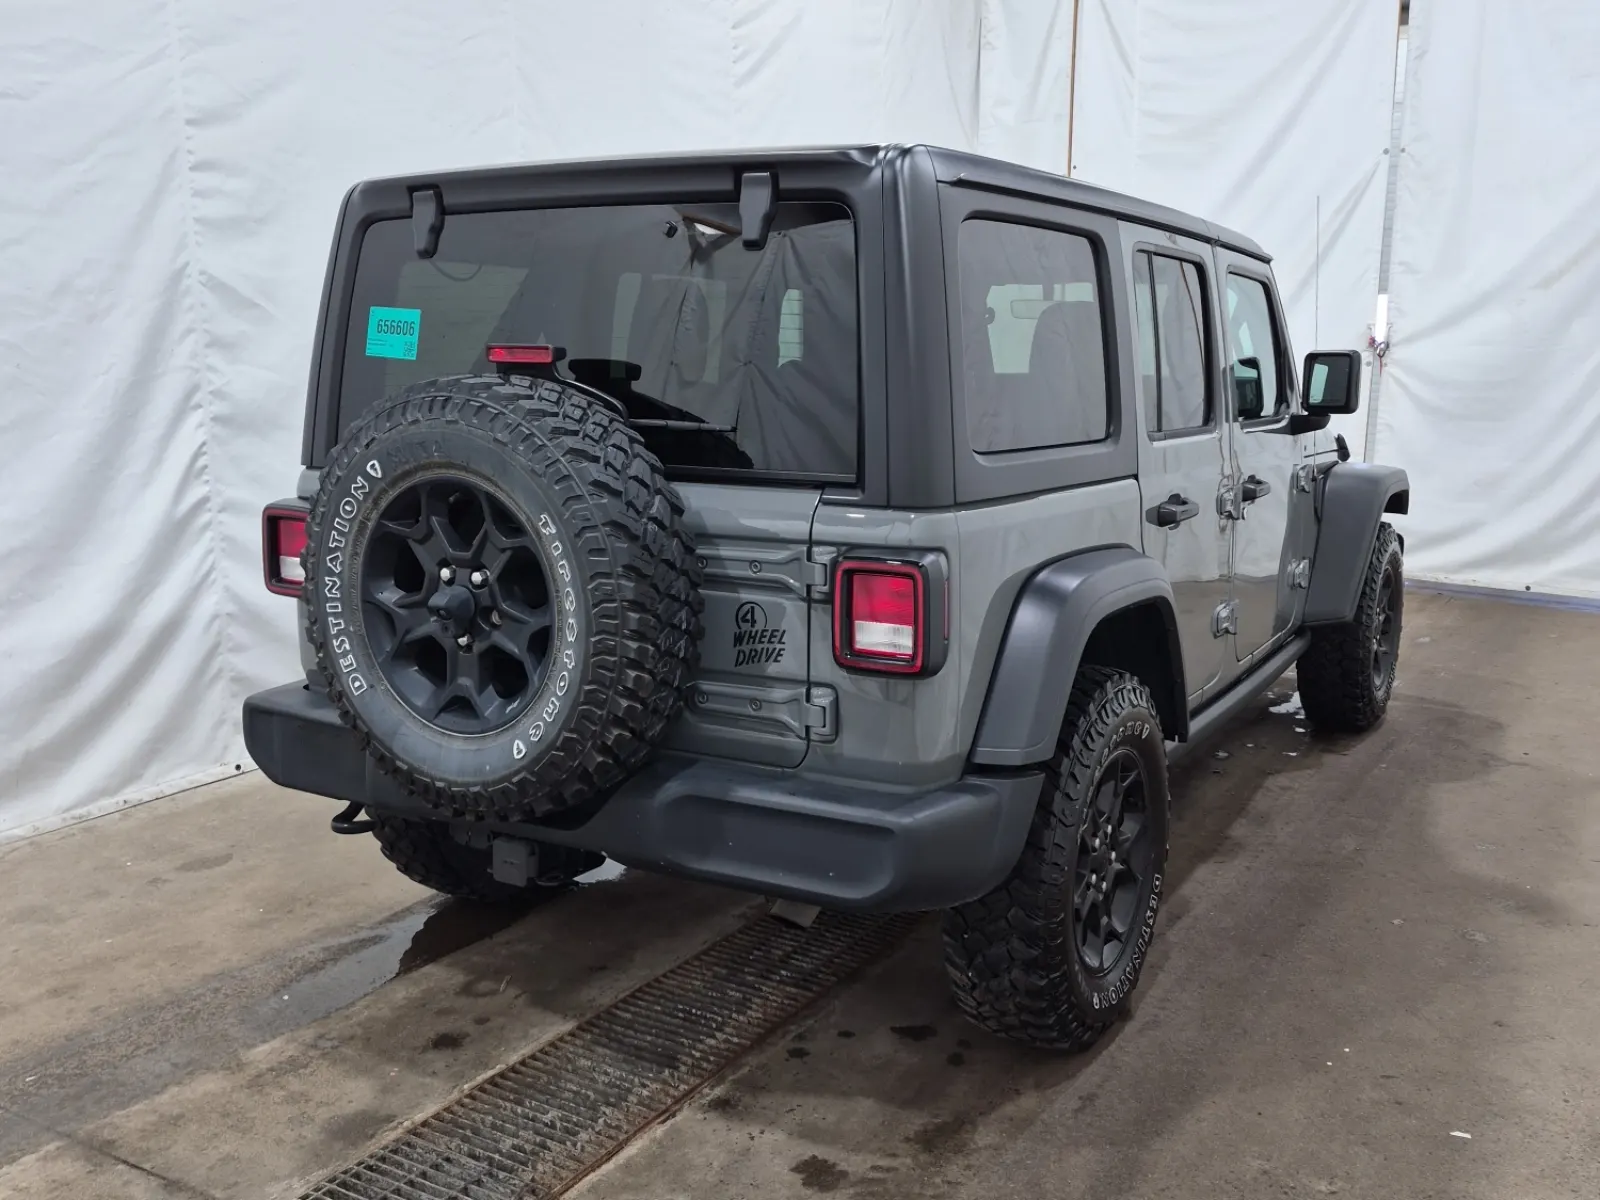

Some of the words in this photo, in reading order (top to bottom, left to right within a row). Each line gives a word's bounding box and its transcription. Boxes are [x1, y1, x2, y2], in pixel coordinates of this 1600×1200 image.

[376, 318, 416, 337] 656606
[325, 475, 369, 696] DESTINATION
[733, 628, 786, 648] WHEEL
[734, 646, 786, 668] DRIVE
